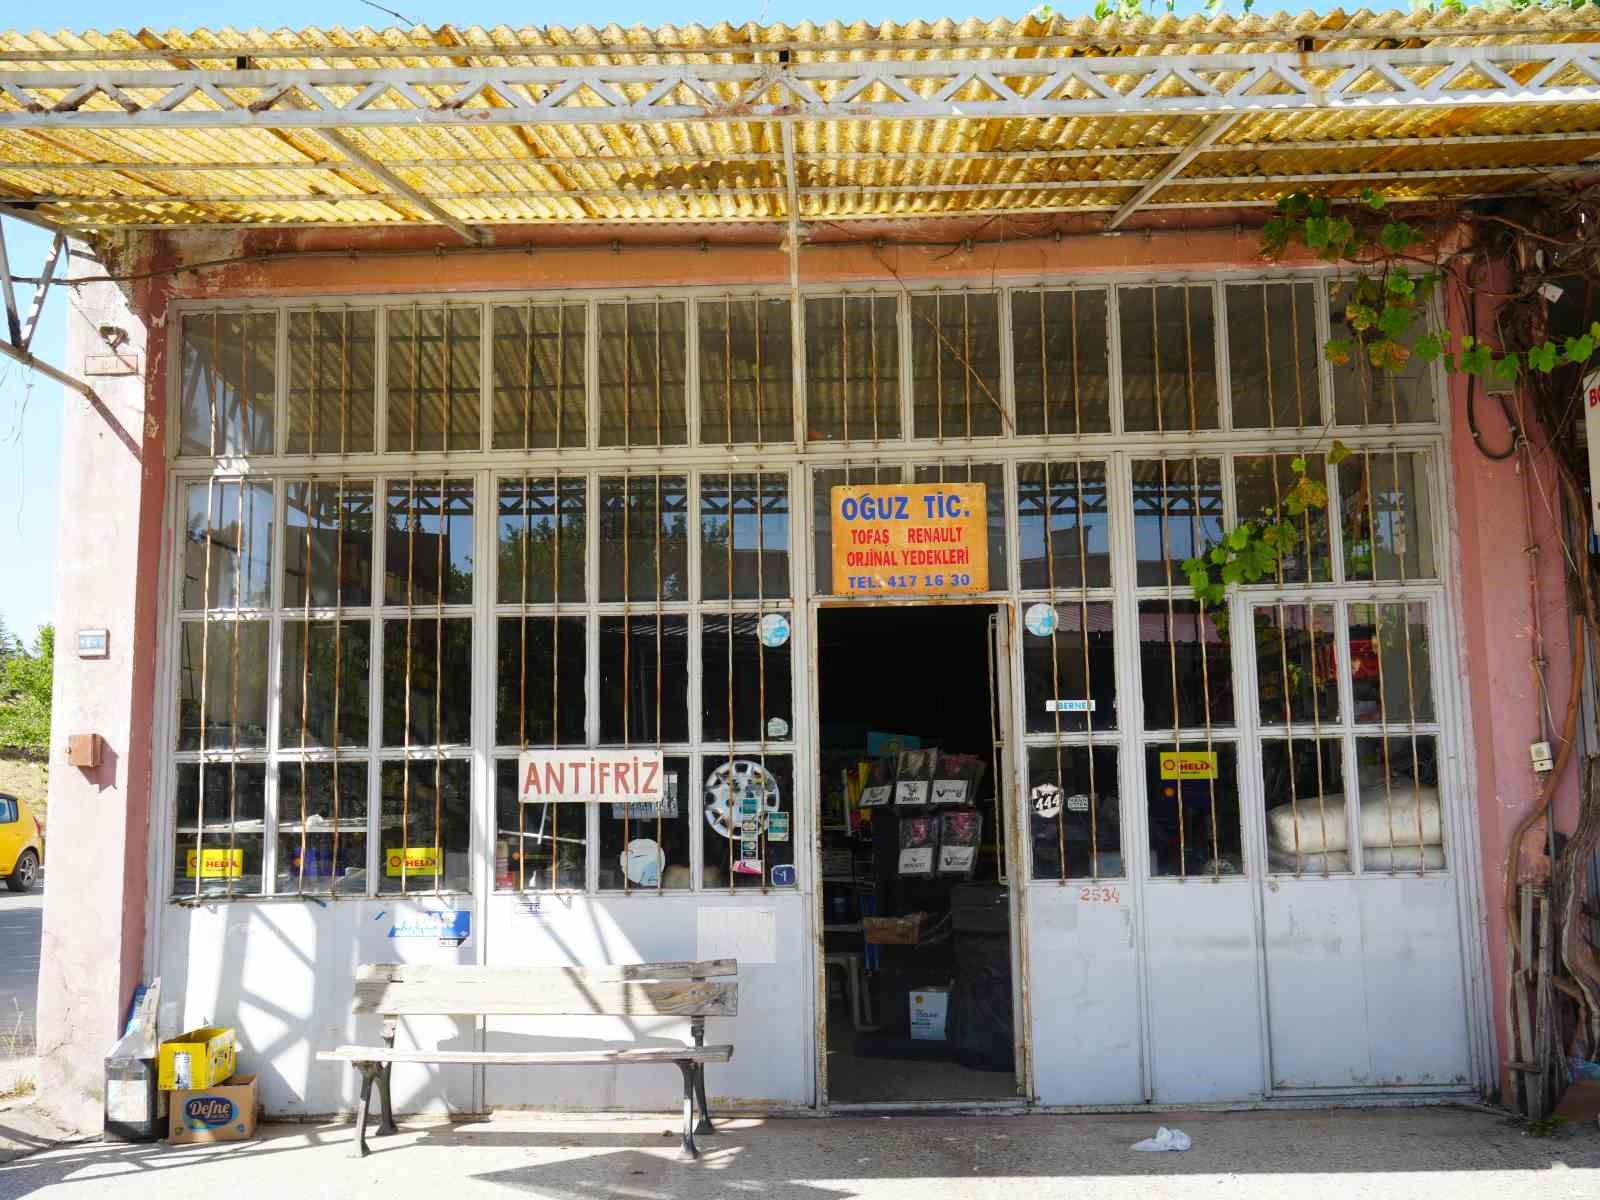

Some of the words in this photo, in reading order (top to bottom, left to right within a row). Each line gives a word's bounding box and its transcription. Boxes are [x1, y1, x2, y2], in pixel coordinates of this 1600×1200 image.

[841, 492, 909, 521] OĞUZ
[923, 491, 970, 519] TİC.
[851, 527, 890, 547] TOFAŞ
[907, 527, 962, 543] RENAULT
[847, 548, 898, 567] ORJİNAL
[901, 546, 969, 565] YEDEKLERİ
[887, 575, 917, 588] 417
[924, 574, 944, 587] 16
[951, 574, 970, 586] 30
[523, 756, 659, 795] ANTİFRİZ
[1034, 791, 1061, 811] 444
[1080, 887, 1120, 903] 2534
[191, 1100, 231, 1119] Defne
